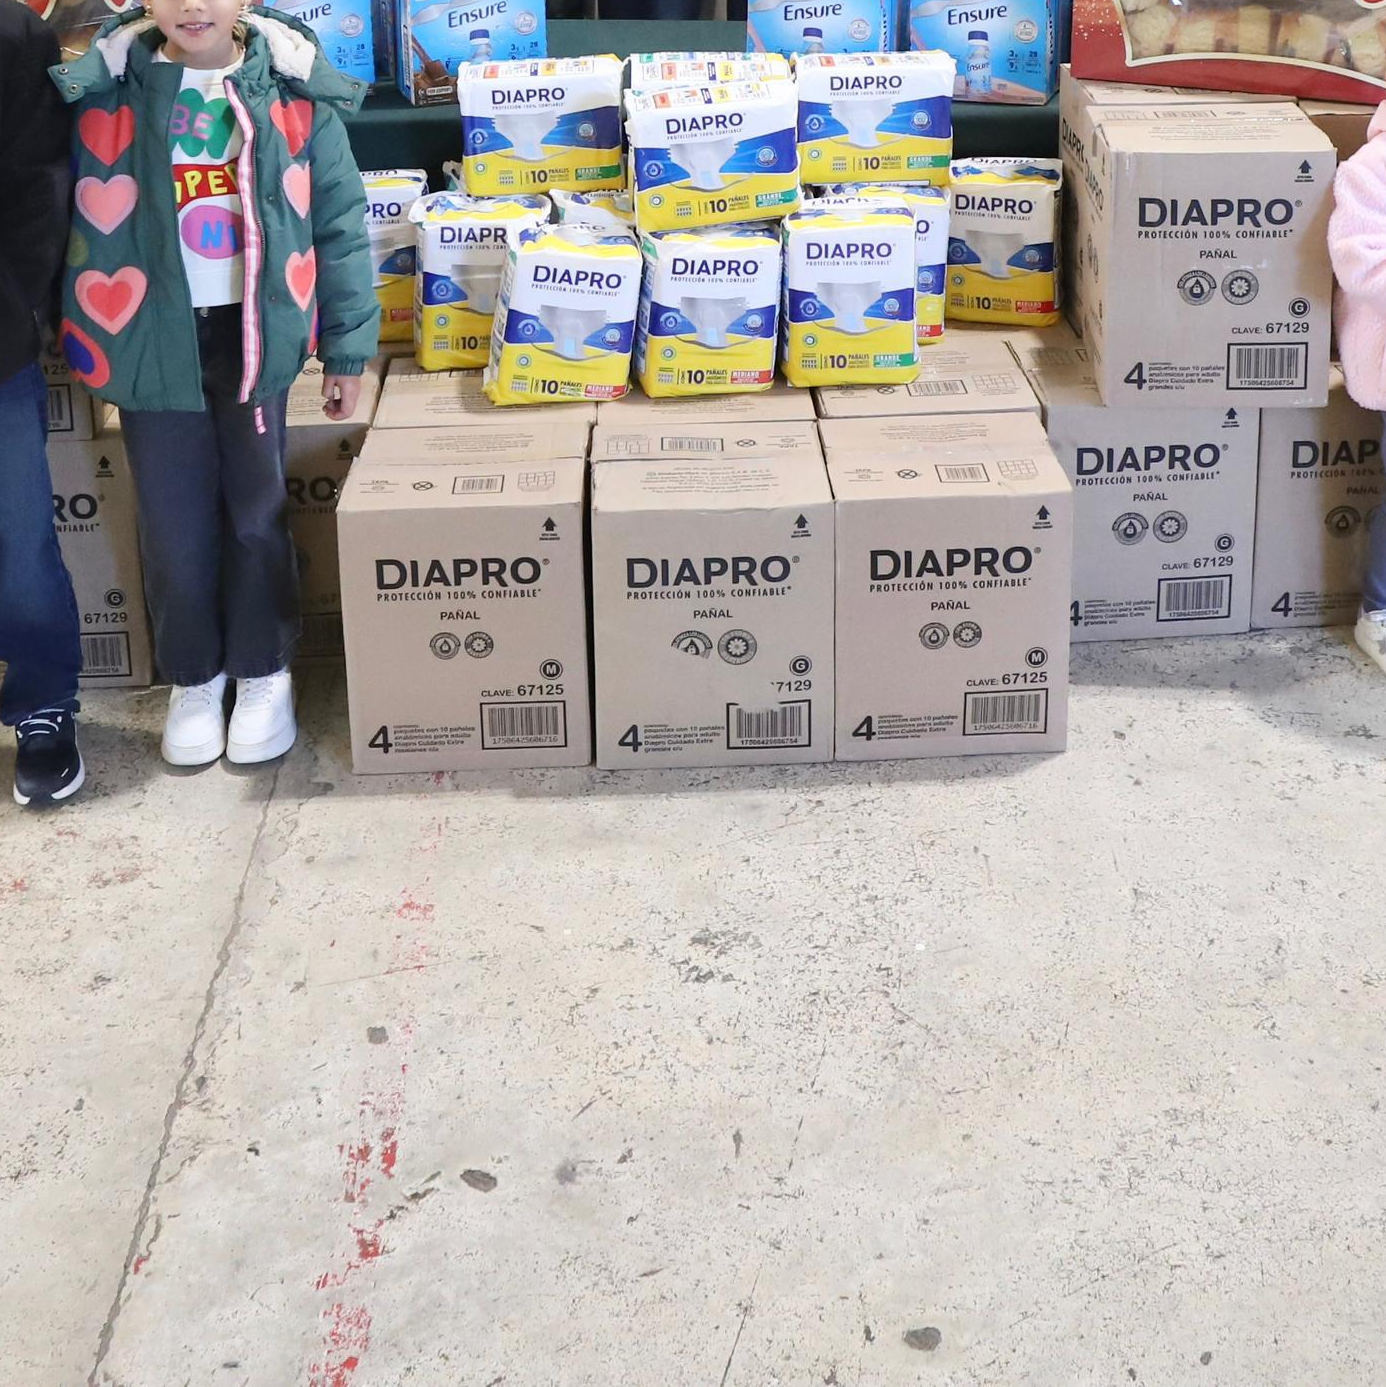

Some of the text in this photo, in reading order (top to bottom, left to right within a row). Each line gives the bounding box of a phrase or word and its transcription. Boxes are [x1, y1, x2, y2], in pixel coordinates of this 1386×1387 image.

[294, 3, 332, 22] sure
[448, 0, 507, 28] Ensure
[784, 3, 842, 21] Ensure
[947, 4, 1008, 26] Ensure
[830, 75, 902, 91] DIAPRO
[491, 87, 565, 105] DIAPRO
[170, 104, 213, 140] BE
[666, 112, 743, 135] DIAPRO
[863, 156, 880, 170] 10
[530, 169, 548, 184] 10
[709, 198, 727, 213] 10
[955, 194, 1033, 214] DIAPRO
[1138, 197, 1294, 227] DIAPRO
[440, 226, 507, 244] DIAPR
[1138, 229, 1198, 239] PROTECCIÓN
[1204, 230, 1231, 239] 100%
[806, 242, 892, 260] DIAPRO
[1199, 248, 1238, 259] PAÑAL
[671, 257, 759, 276] DIAPRO
[533, 265, 622, 290] DIAPRO
[975, 296, 991, 310] 10
[1295, 302, 1305, 312] G
[1231, 322, 1310, 335] CLAVE: 67129
[461, 335, 478, 350] 10
[829, 354, 847, 369] 10
[44, 364, 69, 375] 125
[687, 369, 705, 385] 10
[1123, 361, 1147, 390] 4
[540, 379, 559, 395] 10
[1076, 443, 1221, 476] DIAPRO
[1291, 439, 1381, 468] DIAP
[1075, 475, 1132, 486] PROTECCIÓN
[1137, 474, 1163, 484] 100%
[1290, 468, 1346, 479] PROTECCIÓN
[1133, 491, 1169, 502] PAÑAL
[1219, 537, 1230, 547] G
[870, 546, 1033, 581] DIAPRO
[1161, 556, 1234, 571] CLAVE: 67129
[375, 557, 541, 590] DIAPRO
[626, 555, 791, 589] DIAPRO
[869, 581, 934, 593] PROTECCIÓN
[939, 580, 968, 591] 100%
[377, 591, 441, 602] PROTECCIÓN
[447, 590, 476, 600] 100%
[626, 590, 691, 601] PROTECCIÓN
[697, 589, 726, 599] 100%
[931, 600, 971, 611] PAÑAL
[1271, 591, 1293, 618] 4
[84, 612, 128, 624] 67129
[440, 610, 481, 621] PAÑAL
[693, 608, 734, 619] PAÑAL
[1031, 652, 1042, 663] M
[545, 664, 558, 675] M
[795, 660, 807, 671] G
[771, 679, 812, 692] 7129
[966, 671, 1048, 687] CLAVE: 67125
[481, 684, 564, 698] CLAVE: 67125
[852, 715, 877, 741] 4
[368, 725, 393, 754] 4
[618, 724, 643, 753] 4
